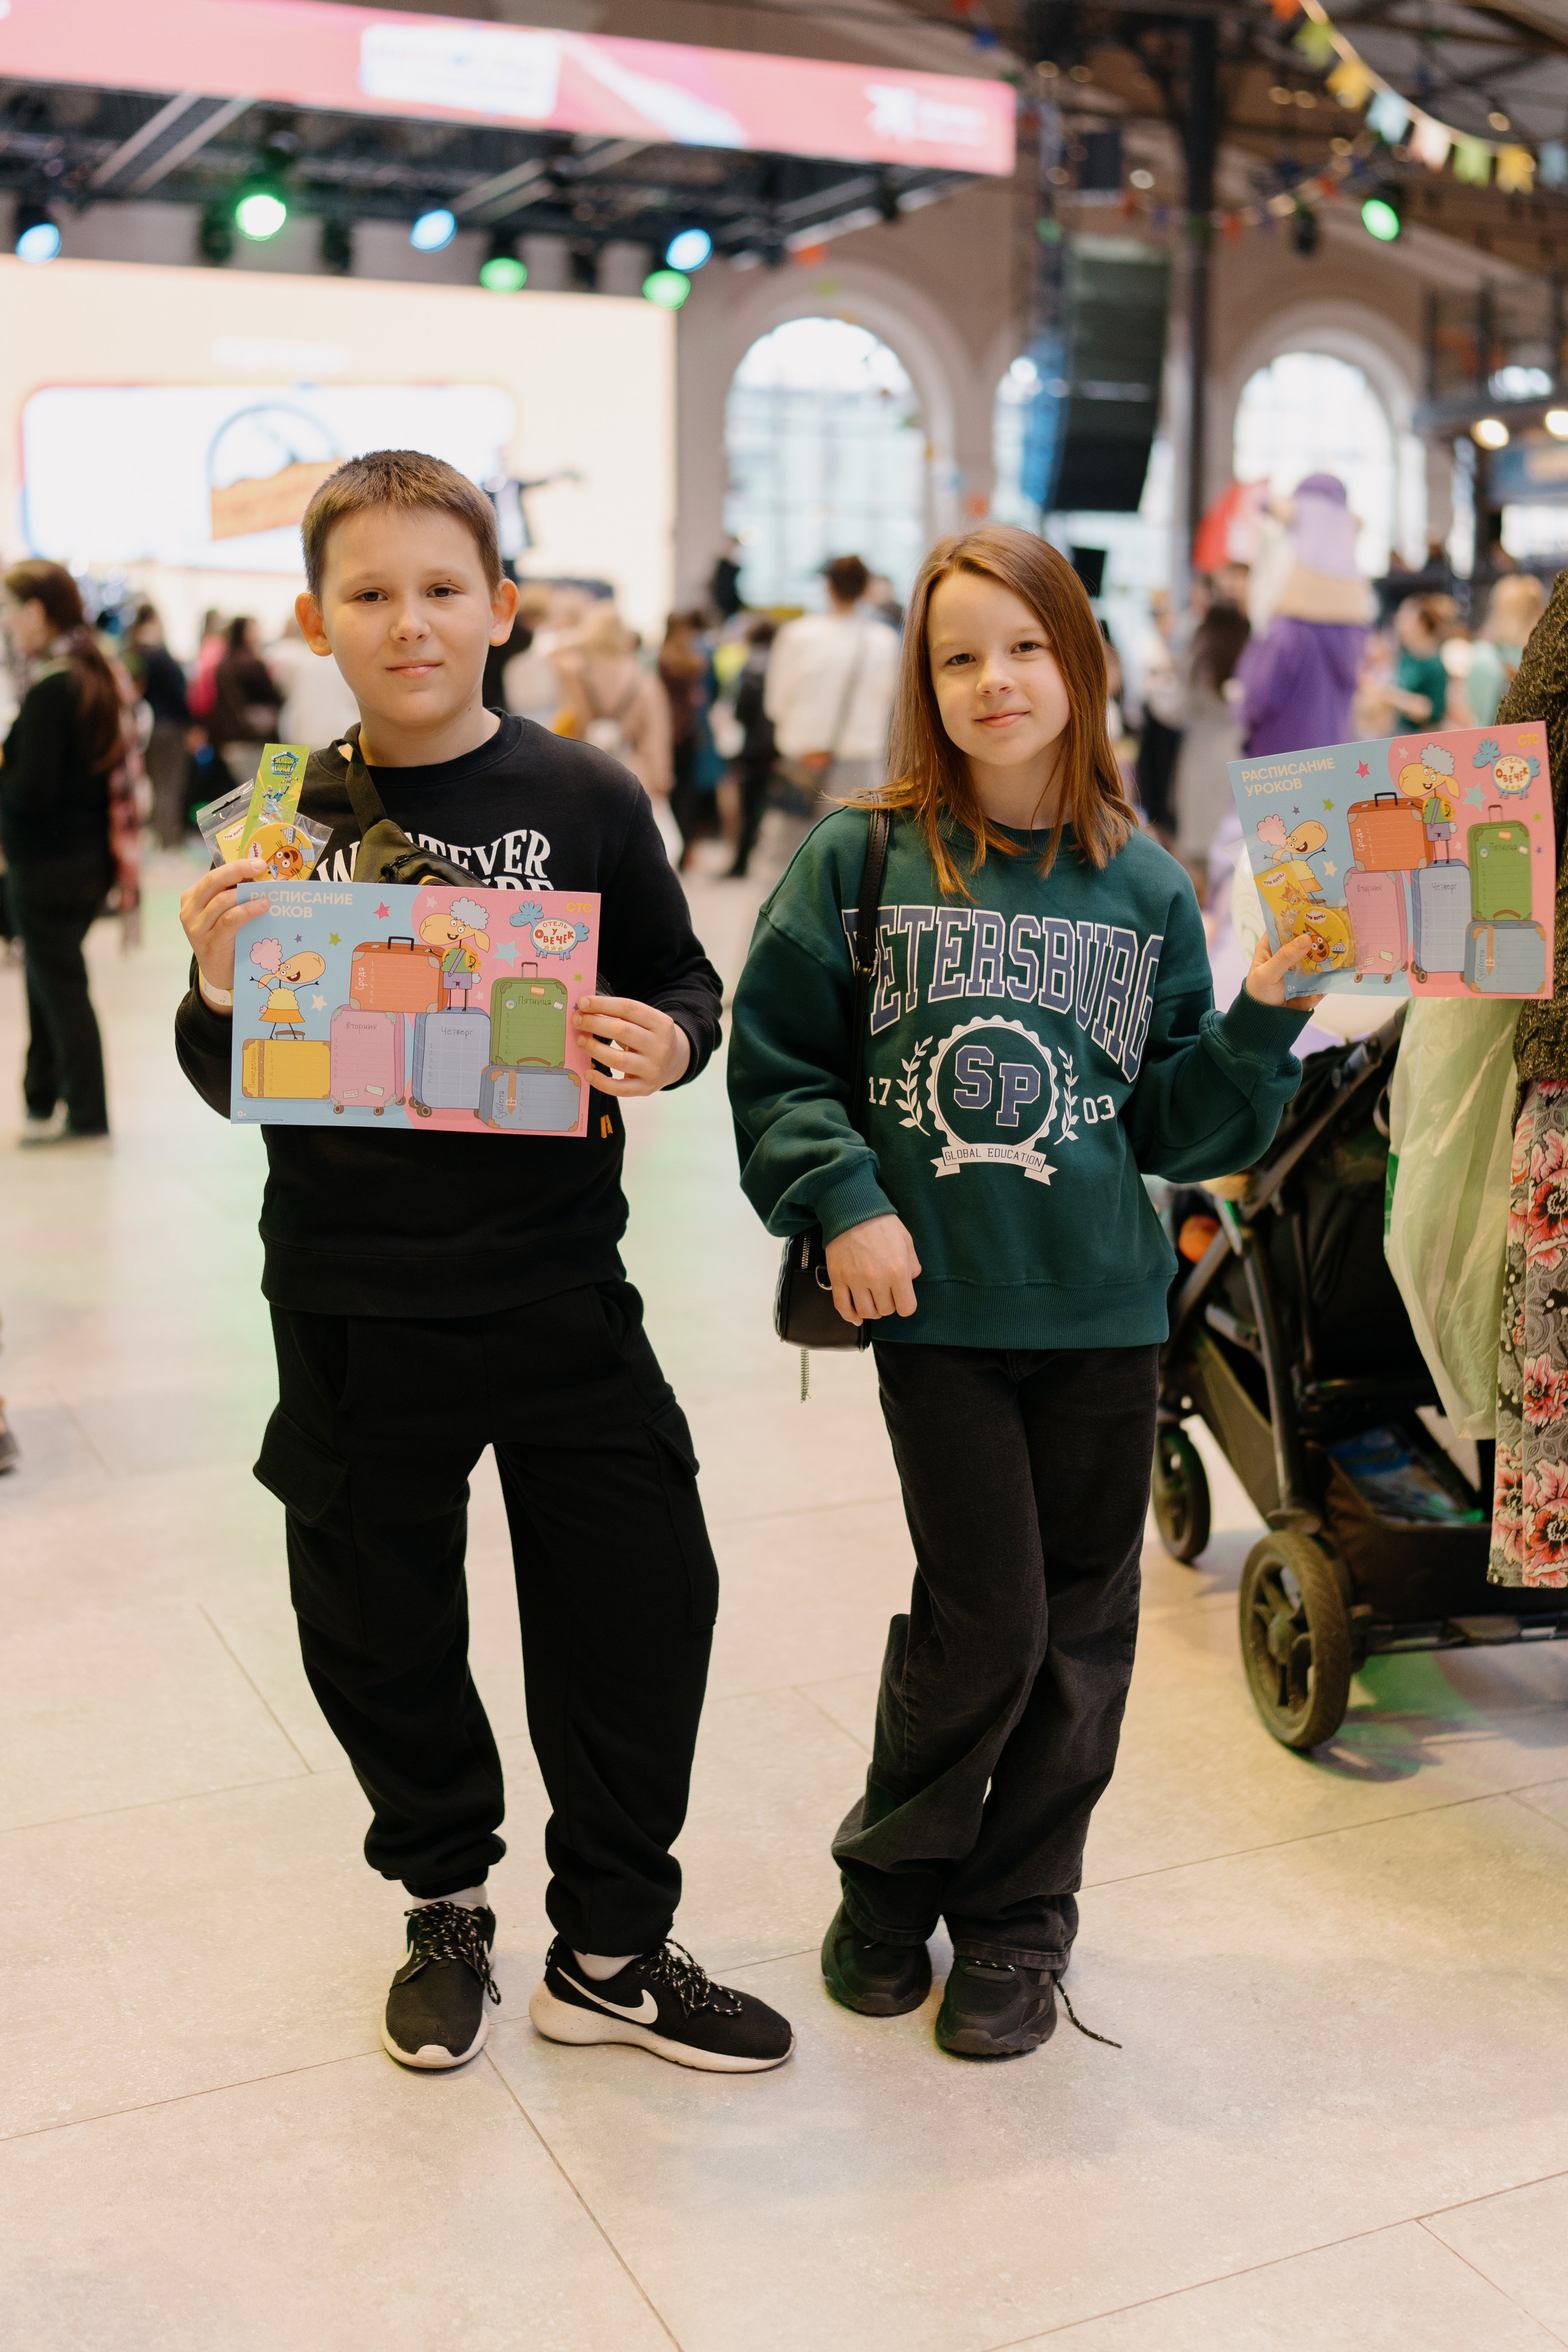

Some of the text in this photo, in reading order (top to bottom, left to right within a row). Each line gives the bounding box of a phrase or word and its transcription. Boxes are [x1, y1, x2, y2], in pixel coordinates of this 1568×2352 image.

[1518, 734, 1540, 746] СТС
[1241, 757, 1335, 782] РАСПИСАНИЕ
[1496, 767, 1528, 783] ОВЕЧЕК
[1244, 778, 1303, 797] УРОКОВ
[1355, 828, 1367, 851] Среда
[269, 905, 313, 918] ОКОВ
[566, 902, 592, 913] СТС
[535, 929, 575, 944] ОВЕЧЕК
[355, 967, 368, 990] Среда
[519, 996, 551, 1006] Пятница
[441, 1027, 473, 1039] Четверг
[869, 1076, 891, 1106] 17
[953, 1044, 1041, 1127] SP
[1082, 1095, 1115, 1125] 03
[944, 1147, 1043, 1167] GLOBAL EDUCATION
